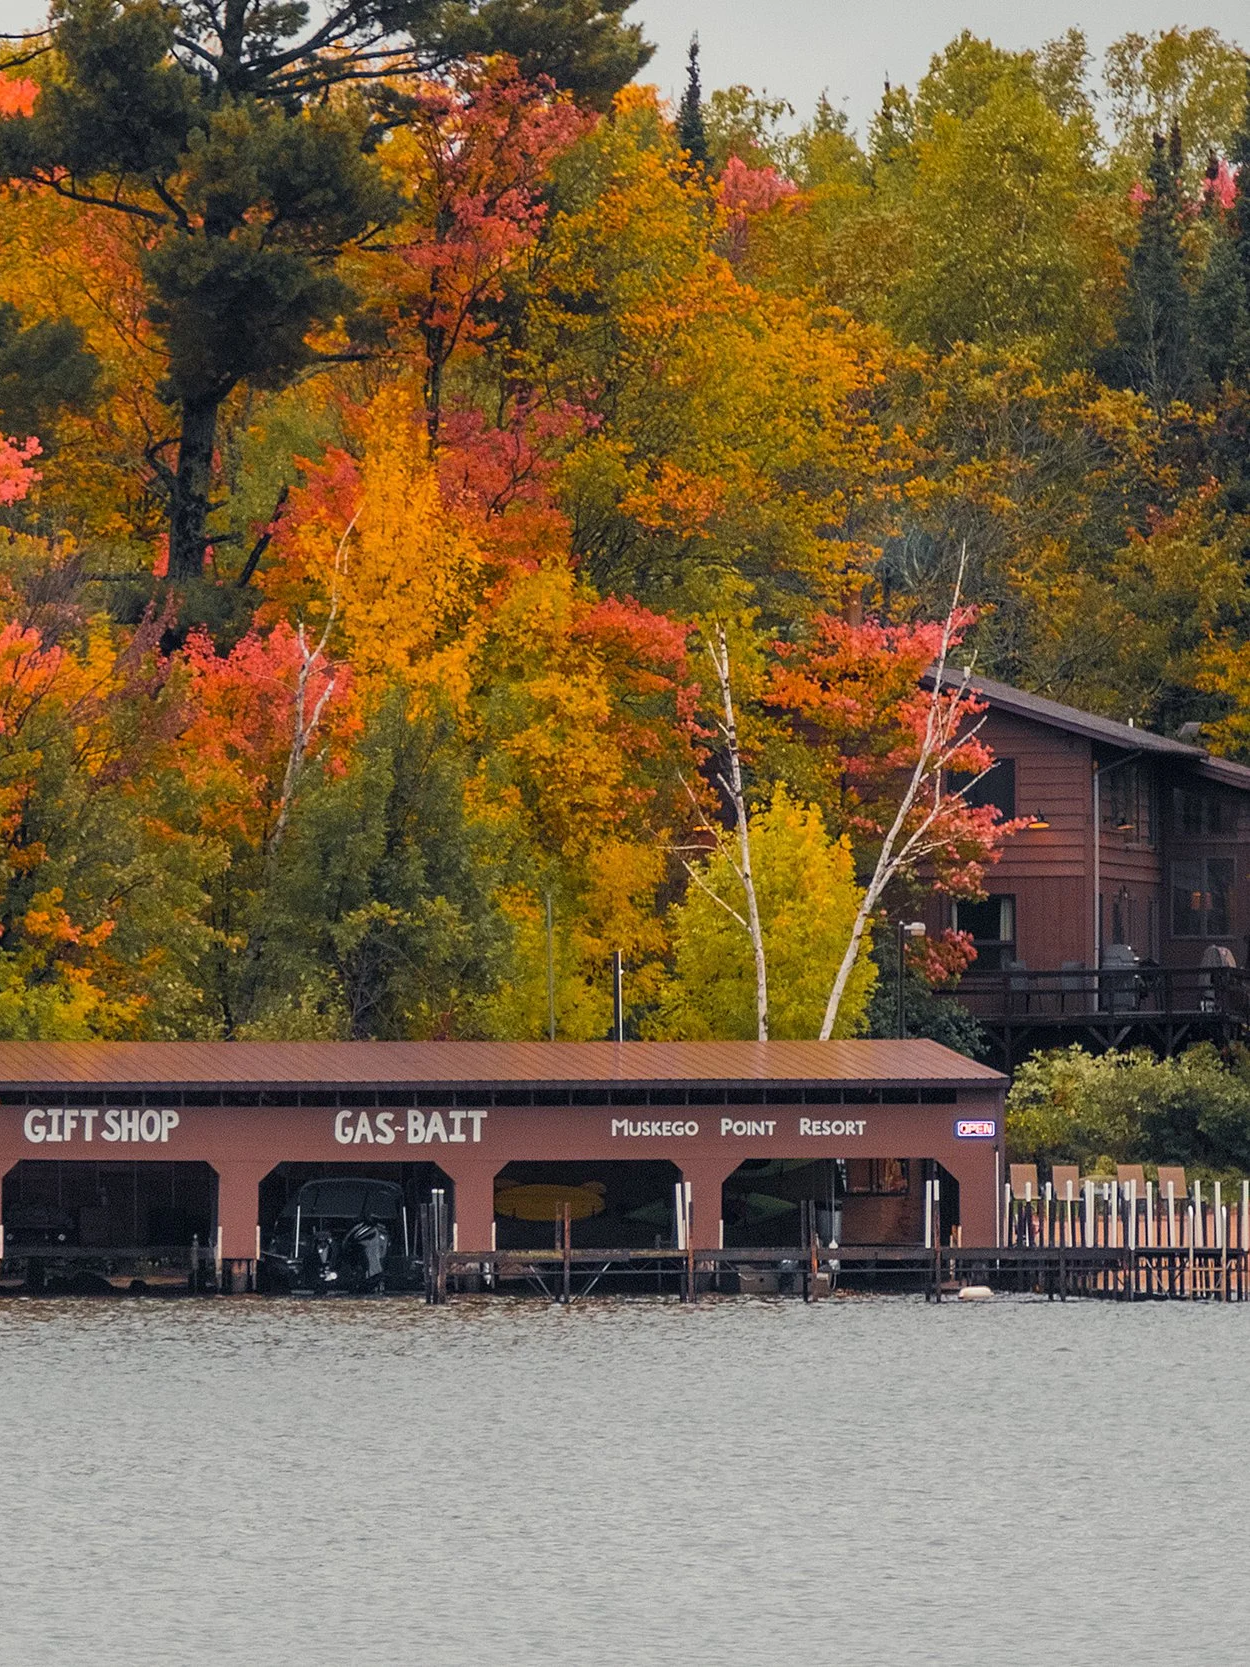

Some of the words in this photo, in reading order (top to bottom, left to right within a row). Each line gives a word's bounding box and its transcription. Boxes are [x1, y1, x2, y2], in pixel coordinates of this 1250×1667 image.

[23, 1109, 99, 1143] GIFT
[100, 1109, 180, 1143] SHOP
[611, 1118, 699, 1137] MUSKEGO
[720, 1118, 777, 1137] POINT
[799, 1117, 867, 1137] RESORT
[960, 1123, 992, 1135] OPEN
